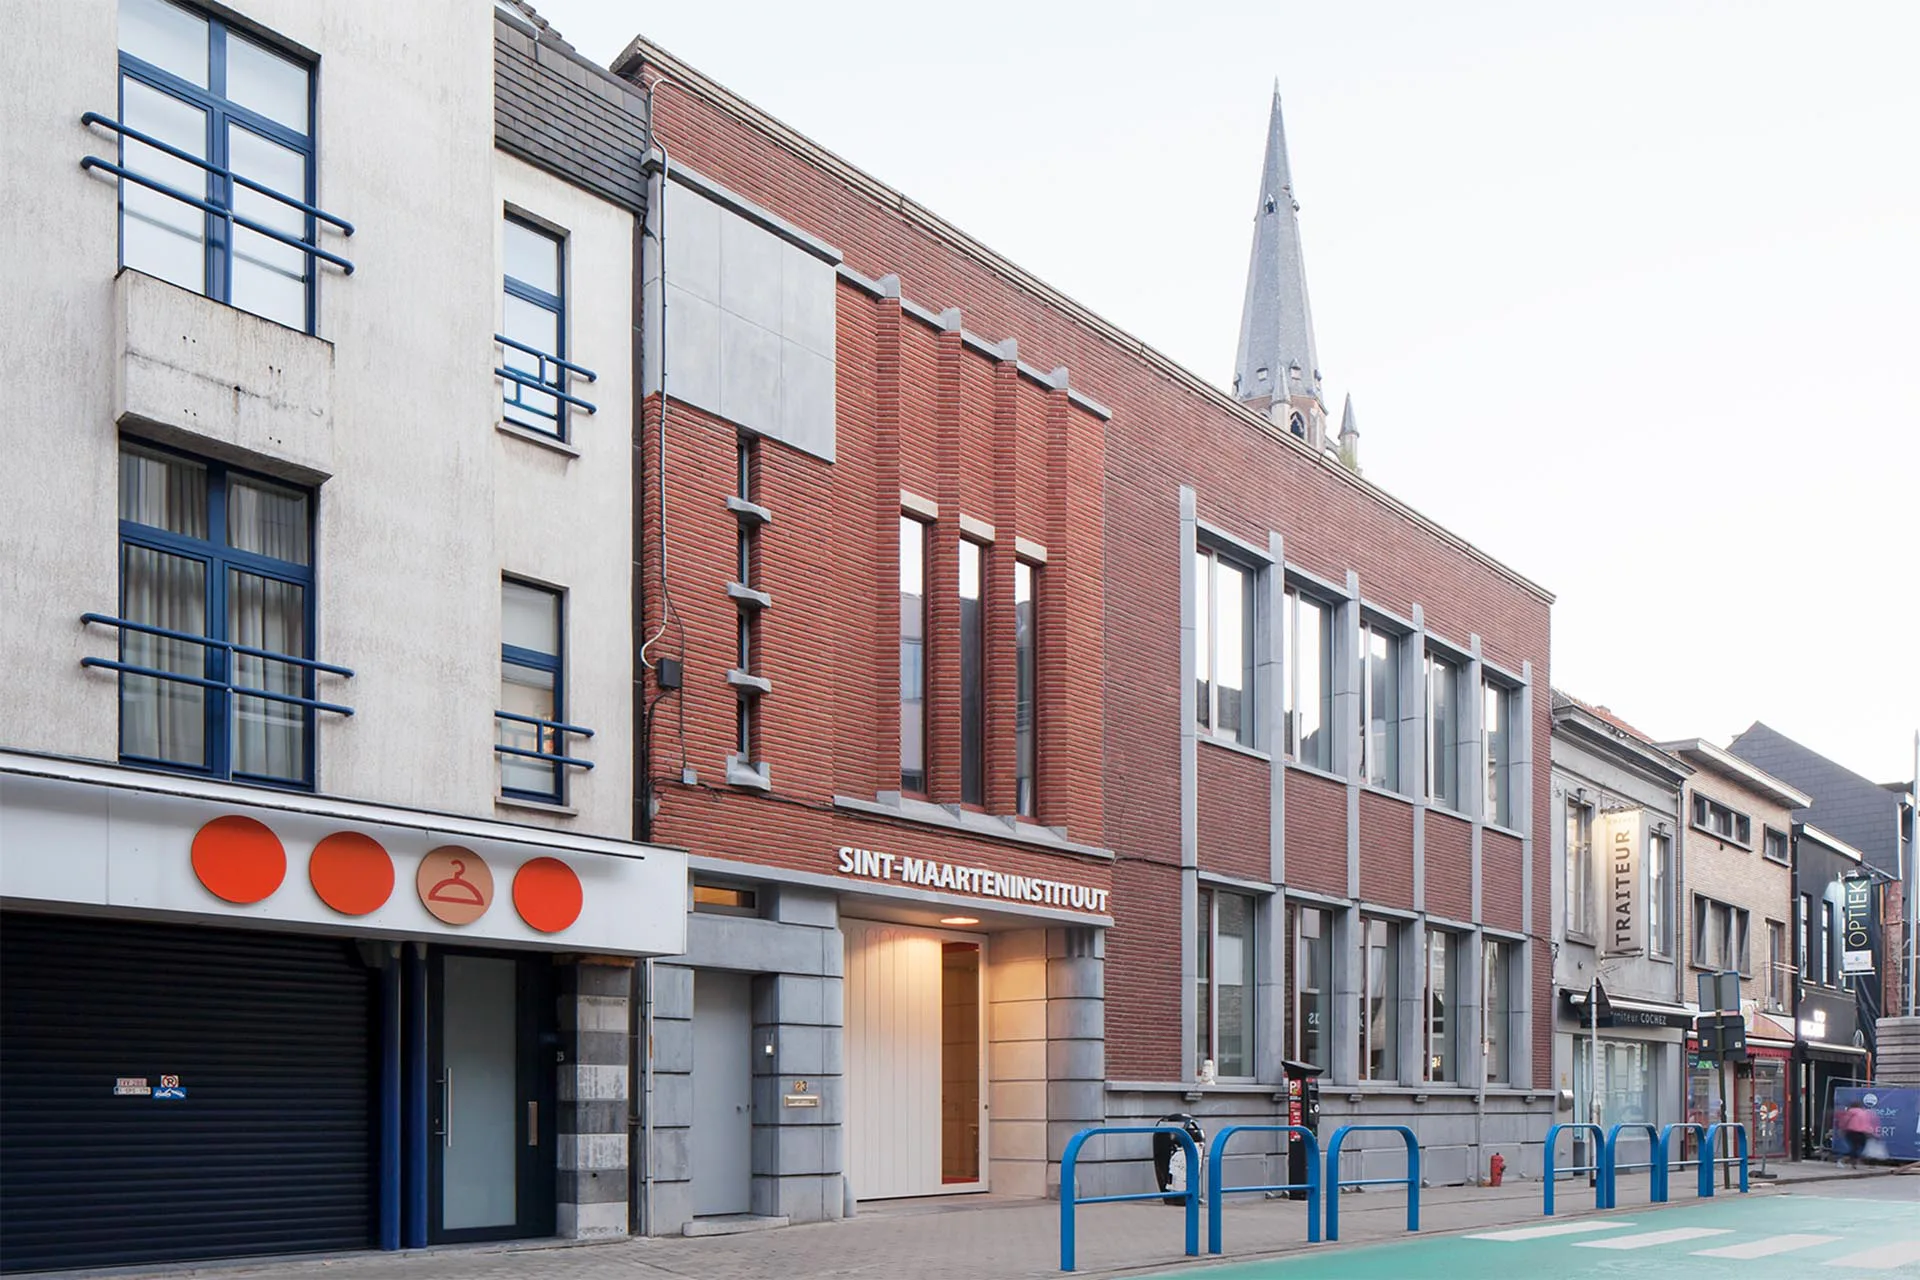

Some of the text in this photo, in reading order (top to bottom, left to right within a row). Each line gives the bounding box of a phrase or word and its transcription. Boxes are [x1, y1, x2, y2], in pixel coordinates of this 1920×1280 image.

[838, 847, 1109, 911] SINT-MAARTENINSTITUUT
[1615, 829, 1631, 946] TRAITEUR
[1848, 880, 1868, 947] OPTIEK
[1640, 1012, 1667, 1026] COCHEZ
